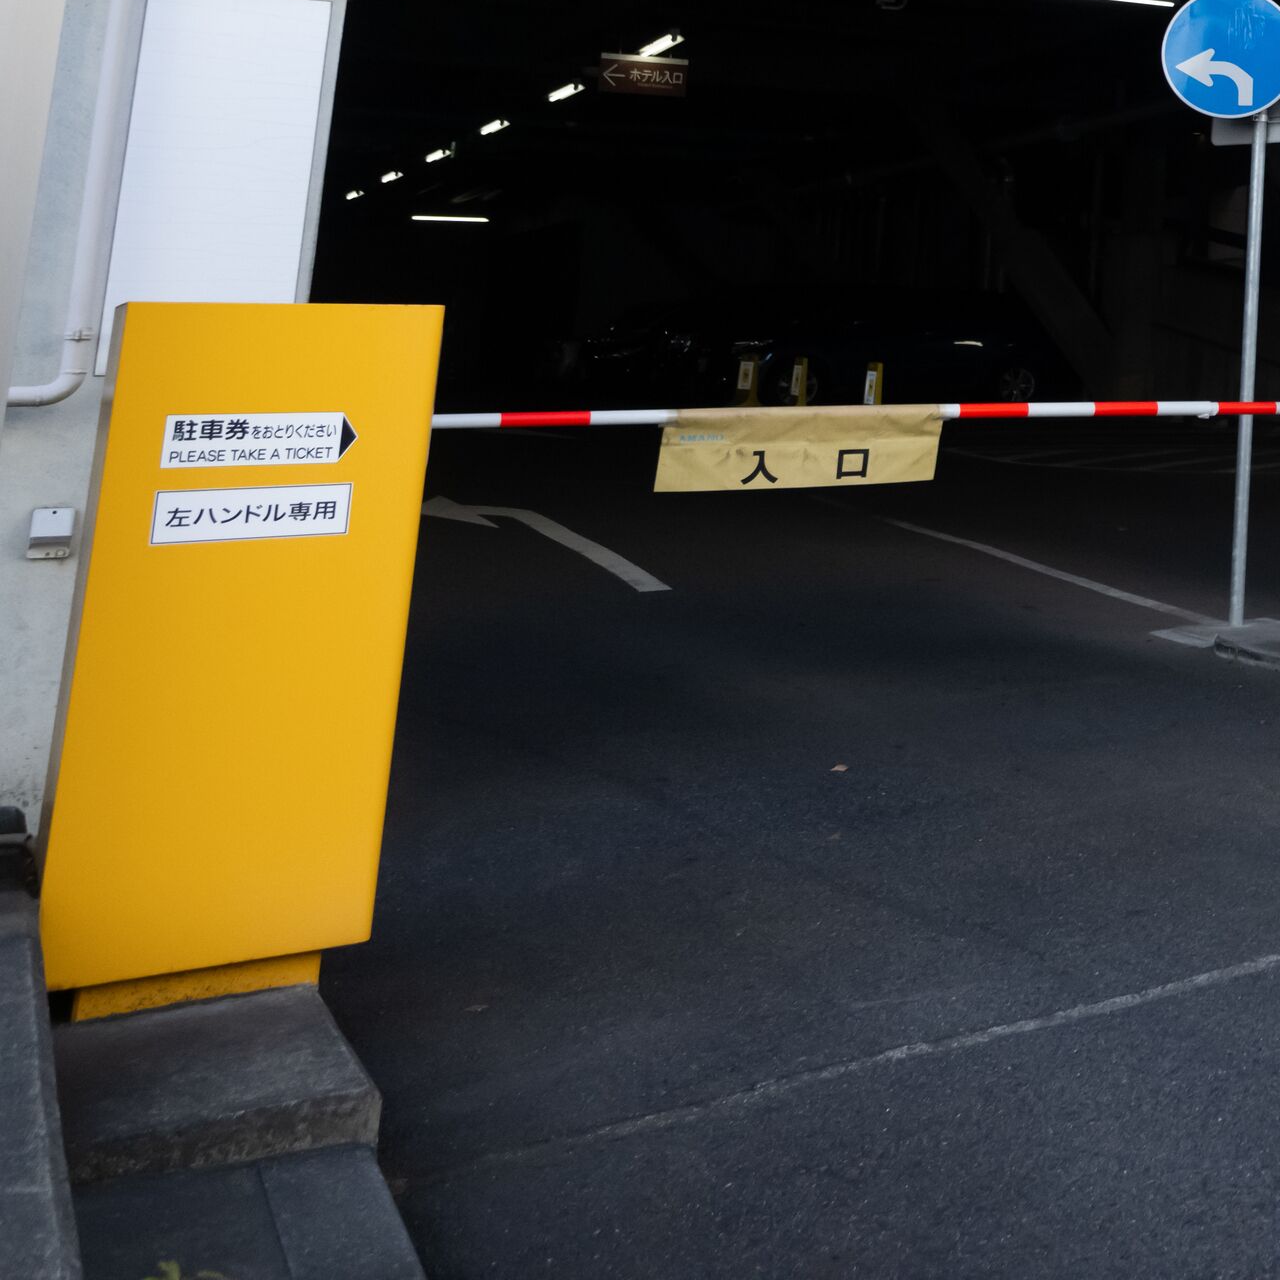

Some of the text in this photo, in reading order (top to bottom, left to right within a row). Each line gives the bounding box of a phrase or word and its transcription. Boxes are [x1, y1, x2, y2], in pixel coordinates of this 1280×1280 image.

[629, 68, 683, 85] ホテル入口
[172, 418, 337, 442] 駐車券をおとりください
[168, 446, 333, 463] PLEASE TAKE A TICKET
[740, 448, 870, 485] 入口
[165, 501, 336, 529] 左ハンドル専用
